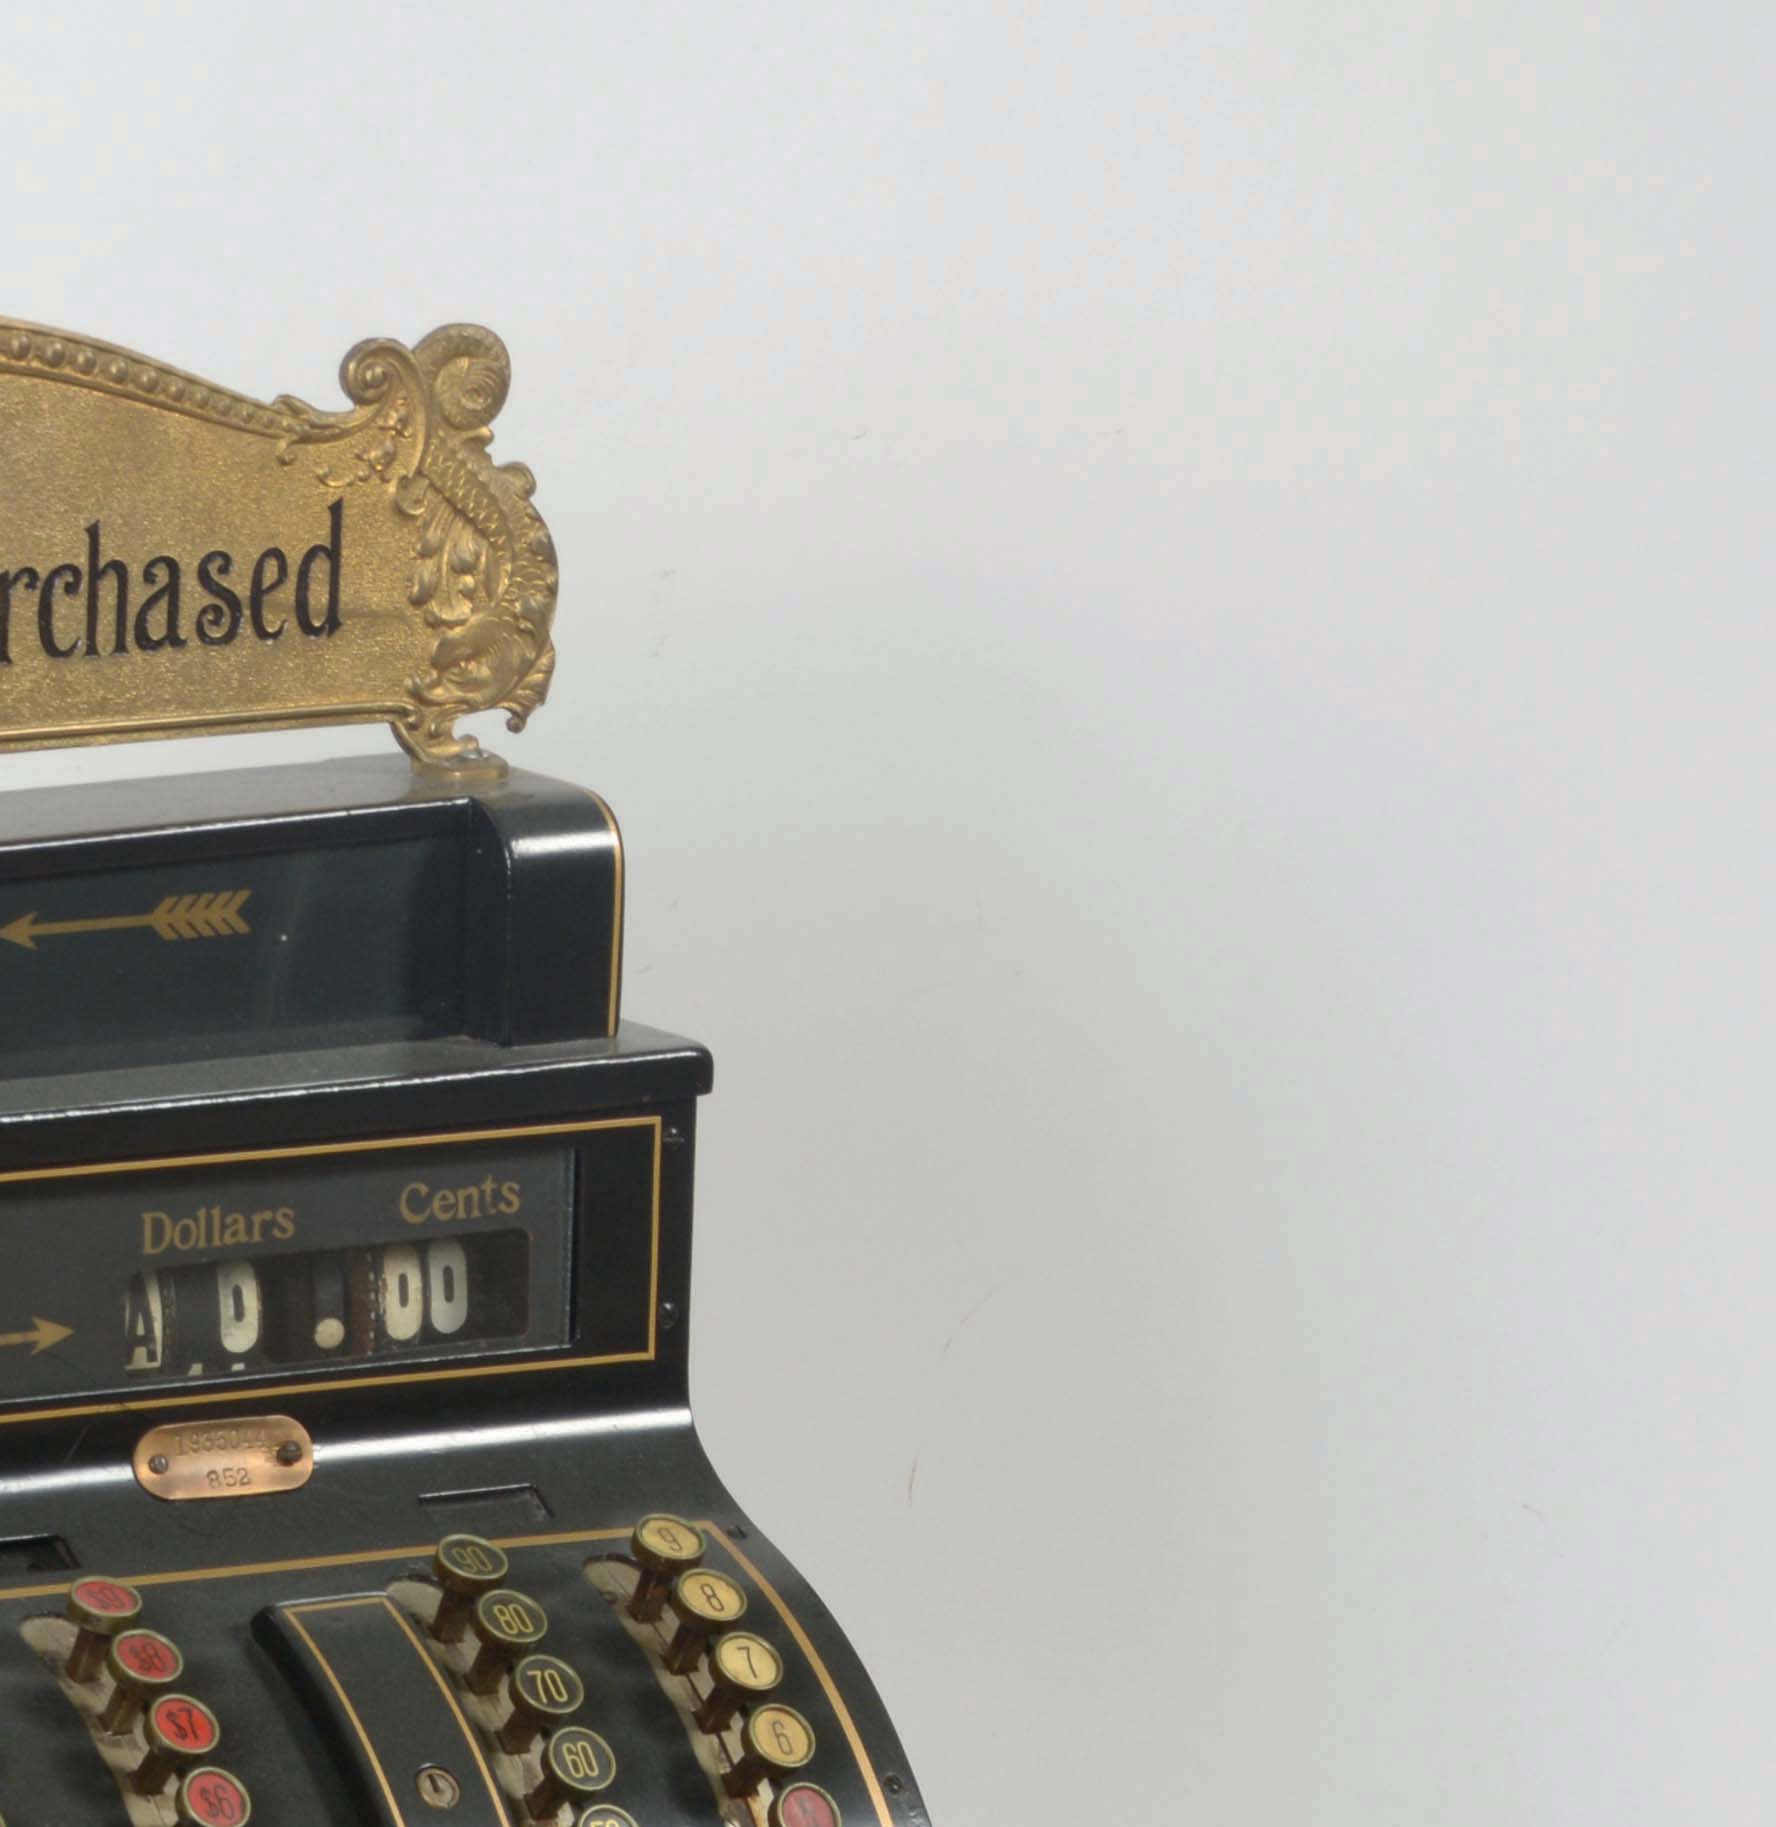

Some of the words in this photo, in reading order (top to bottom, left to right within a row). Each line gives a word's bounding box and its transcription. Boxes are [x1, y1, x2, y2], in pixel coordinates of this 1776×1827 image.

[141, 1205, 296, 1255] Dollars
[399, 1176, 521, 1225] Cents
[205, 1467, 253, 1489] 852
[657, 1527, 683, 1553] 9
[455, 1547, 490, 1573] 90
[701, 1584, 726, 1613] 8
[493, 1604, 533, 1634] 80
[736, 1645, 758, 1679] 7
[528, 1670, 568, 1702] 70
[164, 1706, 200, 1743] $7
[771, 1719, 794, 1756] 6
[562, 1740, 599, 1779] 60
